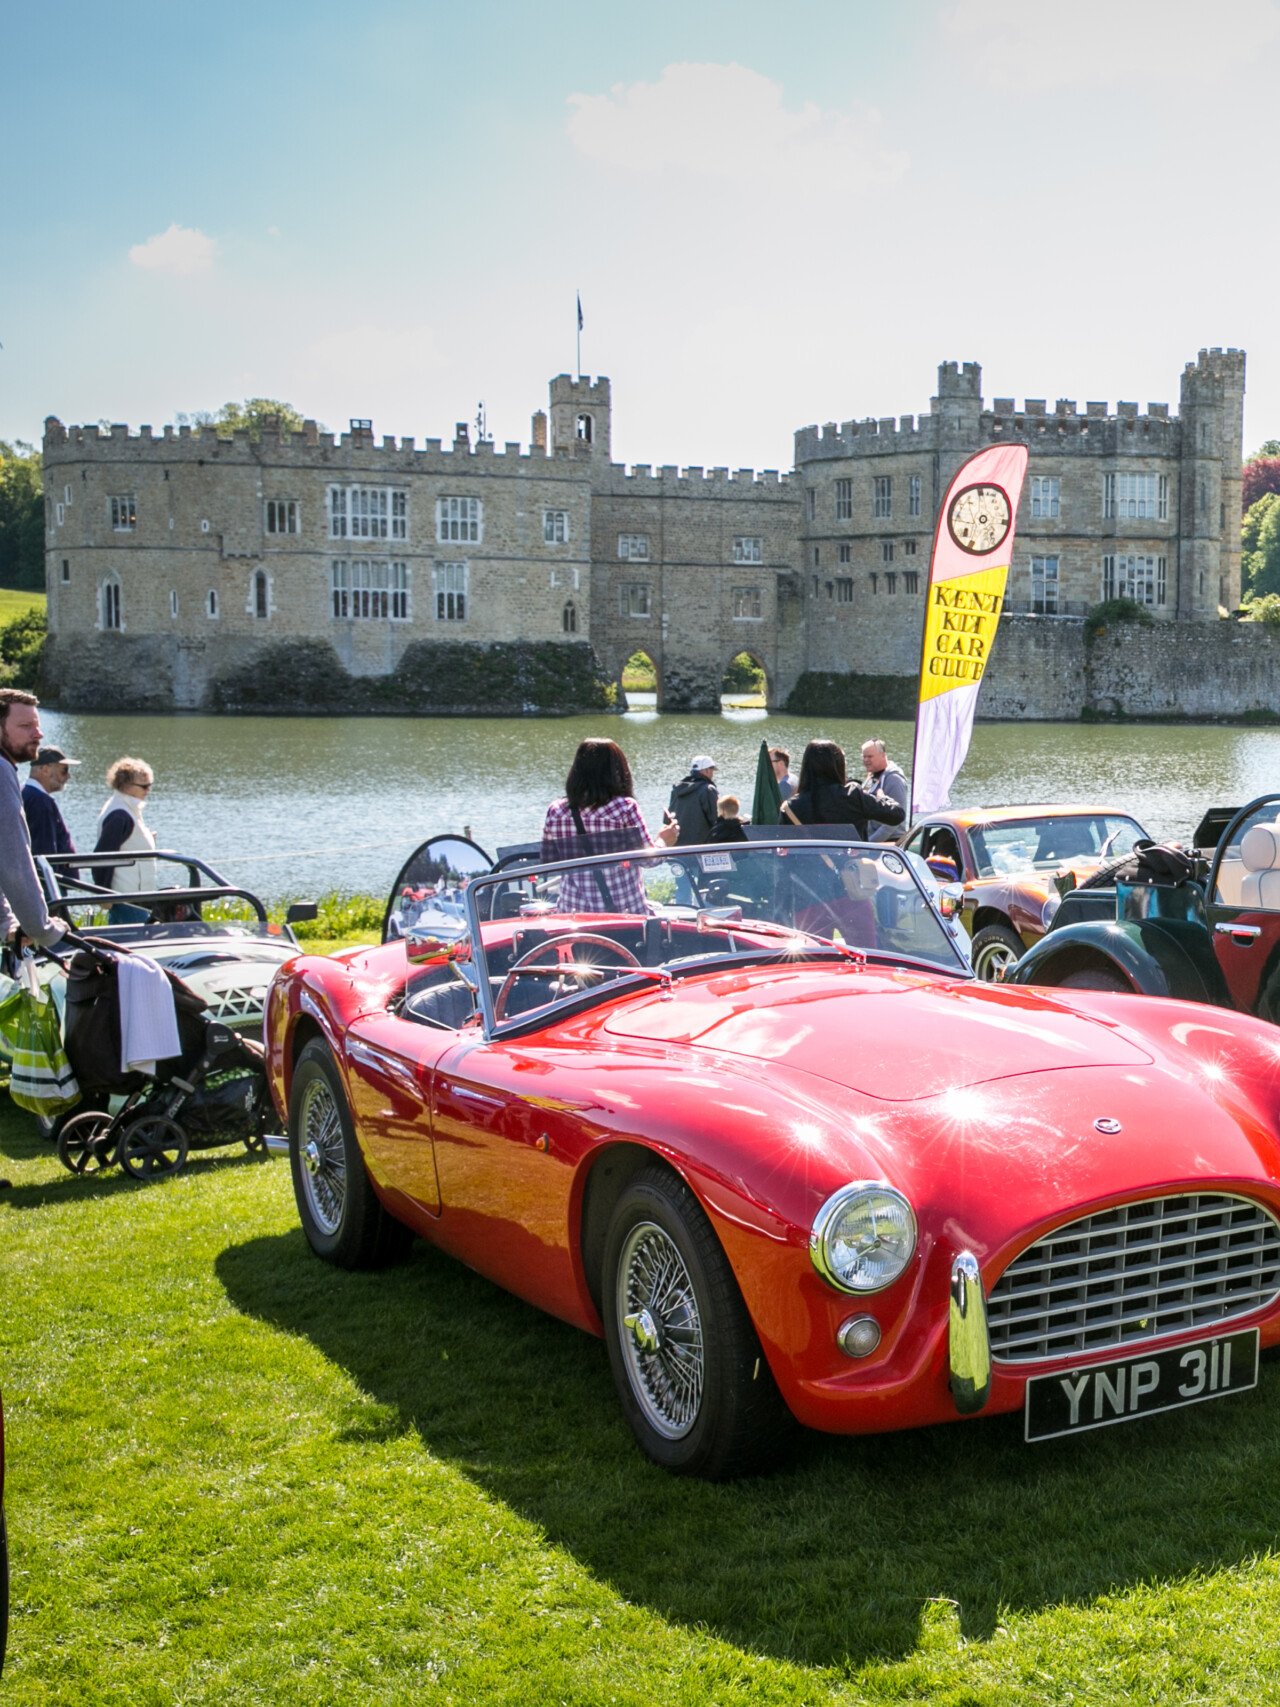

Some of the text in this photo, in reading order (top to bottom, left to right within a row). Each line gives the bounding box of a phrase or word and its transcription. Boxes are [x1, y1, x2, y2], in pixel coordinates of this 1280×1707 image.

[935, 585, 1002, 614] KENT
[942, 610, 986, 635] KIT
[936, 633, 984, 658] CAR
[929, 656, 984, 681] CLUB
[1060, 1342, 1232, 1425] YNP 311
